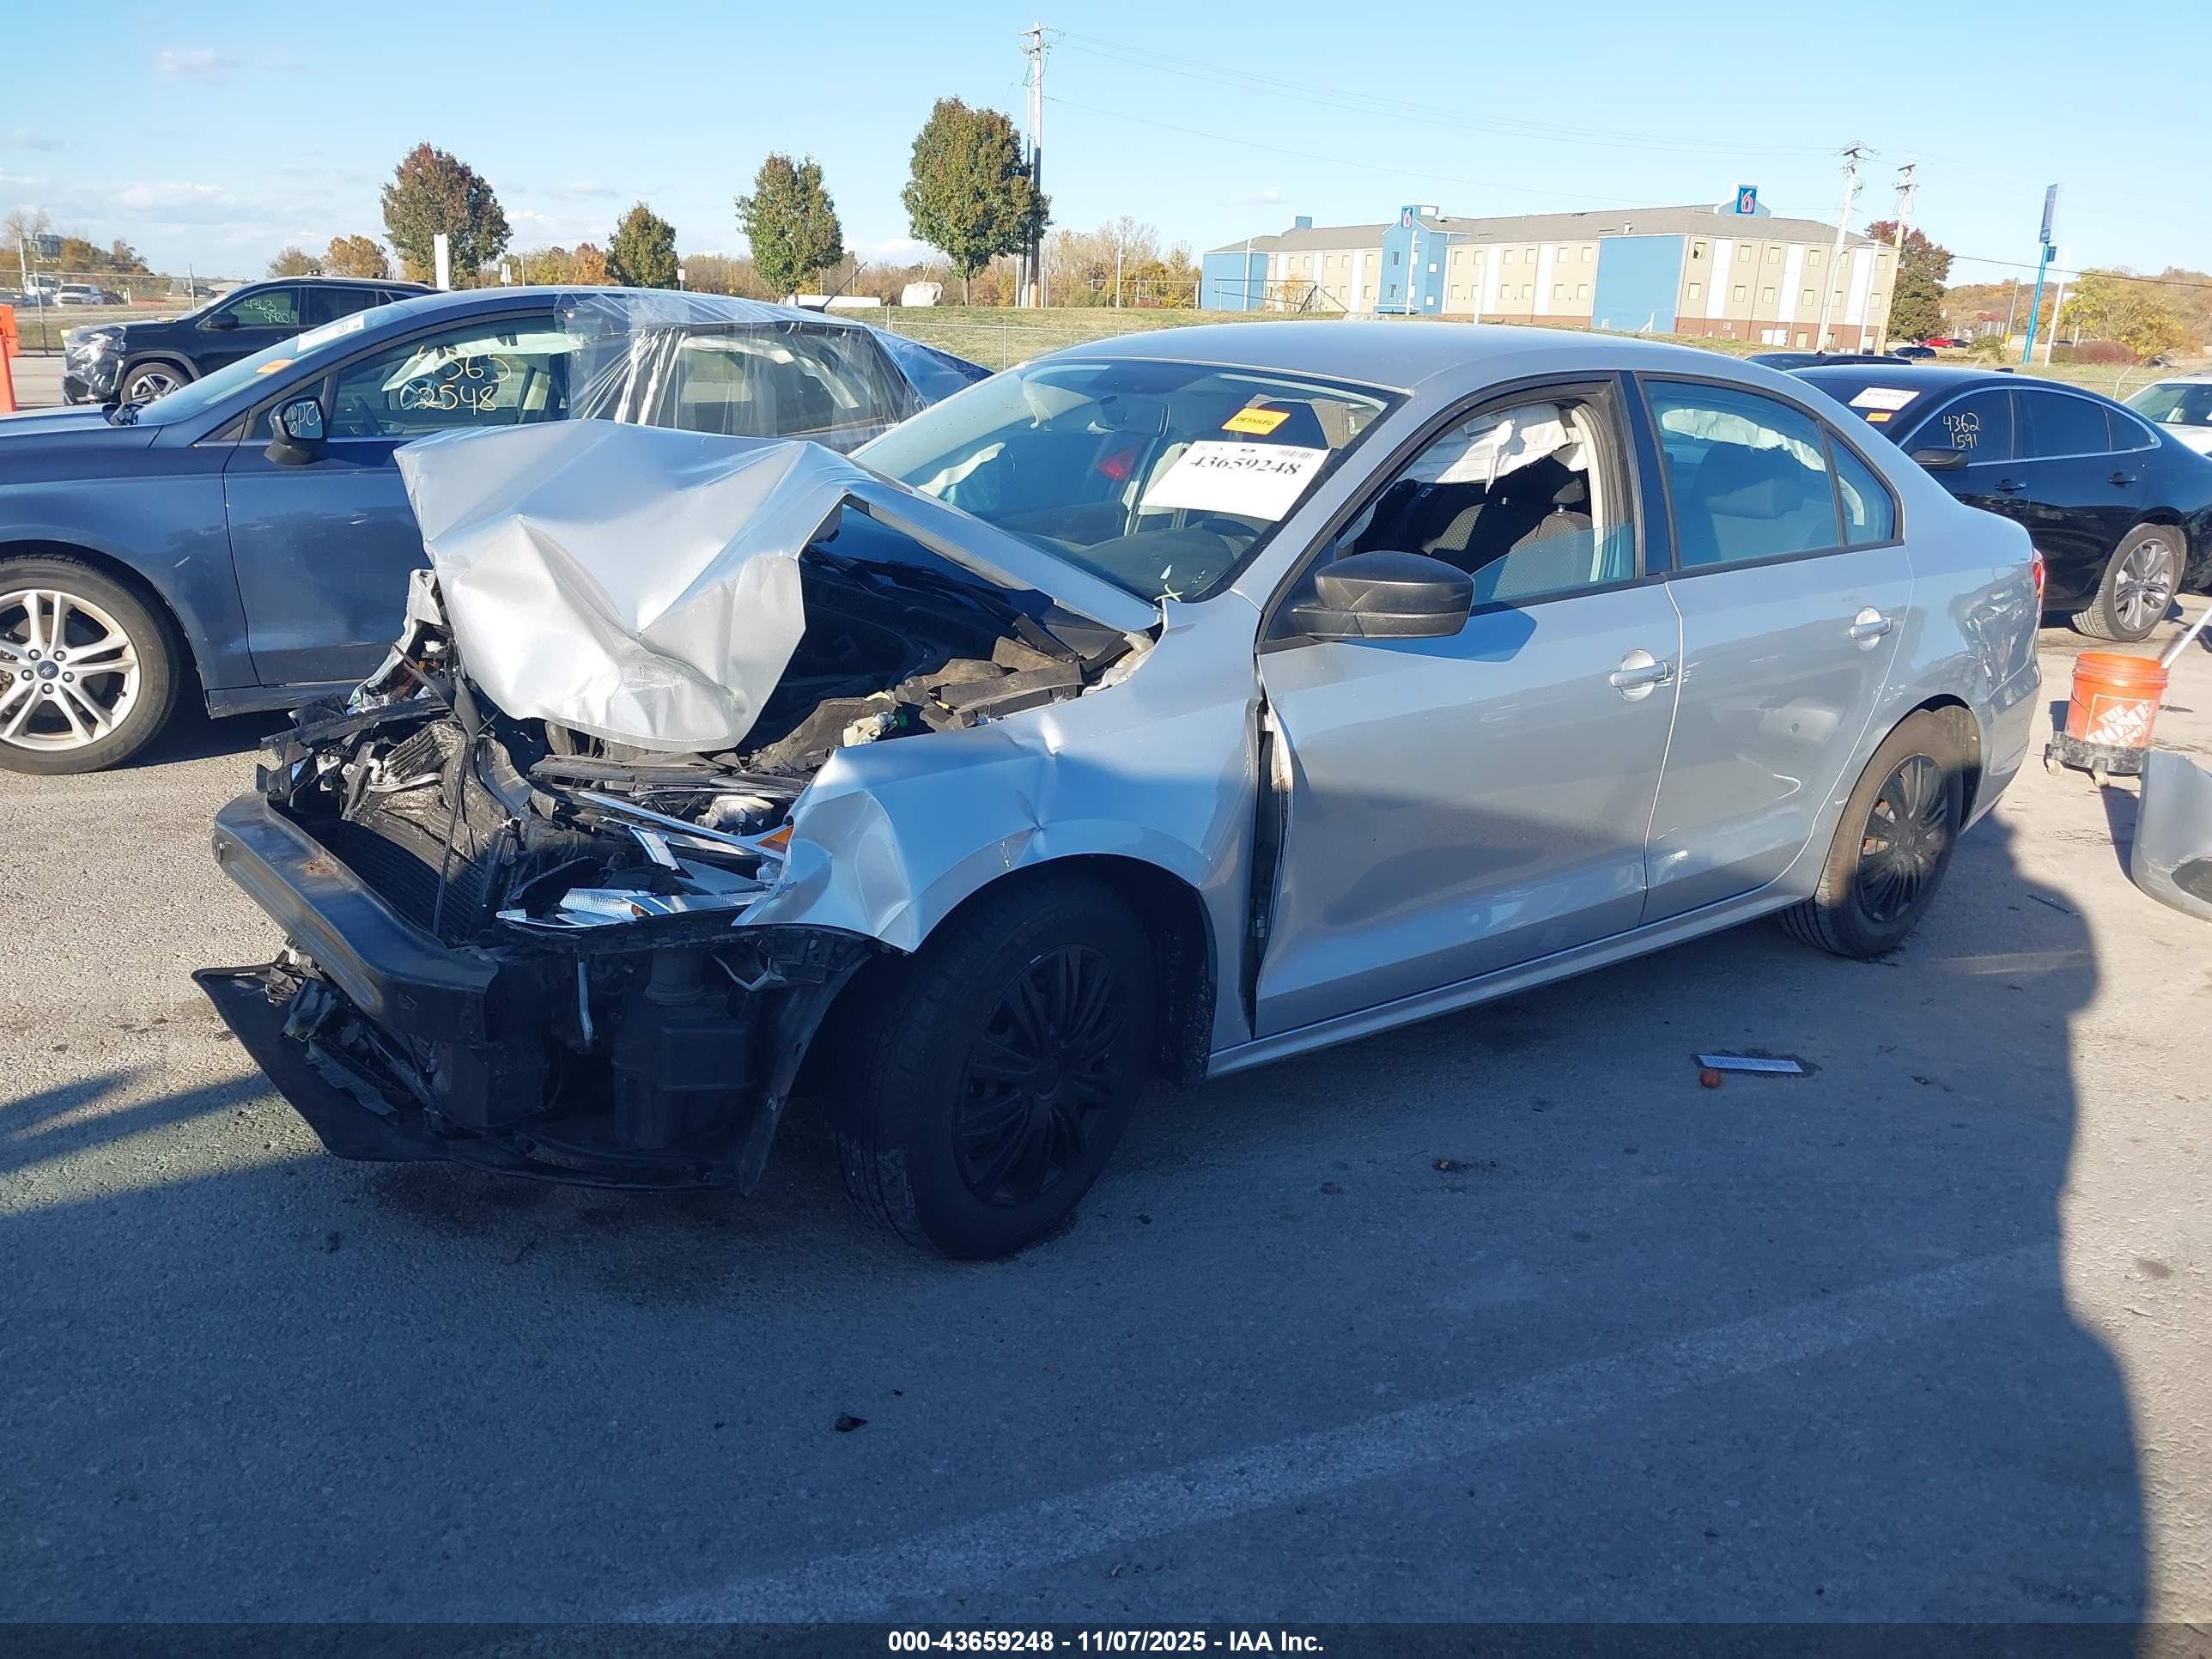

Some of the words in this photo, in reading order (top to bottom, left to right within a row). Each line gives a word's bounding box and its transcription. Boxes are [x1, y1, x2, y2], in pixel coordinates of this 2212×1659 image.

[263, 311, 290, 324] 9920
[413, 385, 497, 416] 2548
[1942, 412, 1981, 432] 4362
[1951, 432, 1978, 449] 1591
[1189, 455, 1302, 476] 43659248
[2095, 703, 2128, 726] THE
